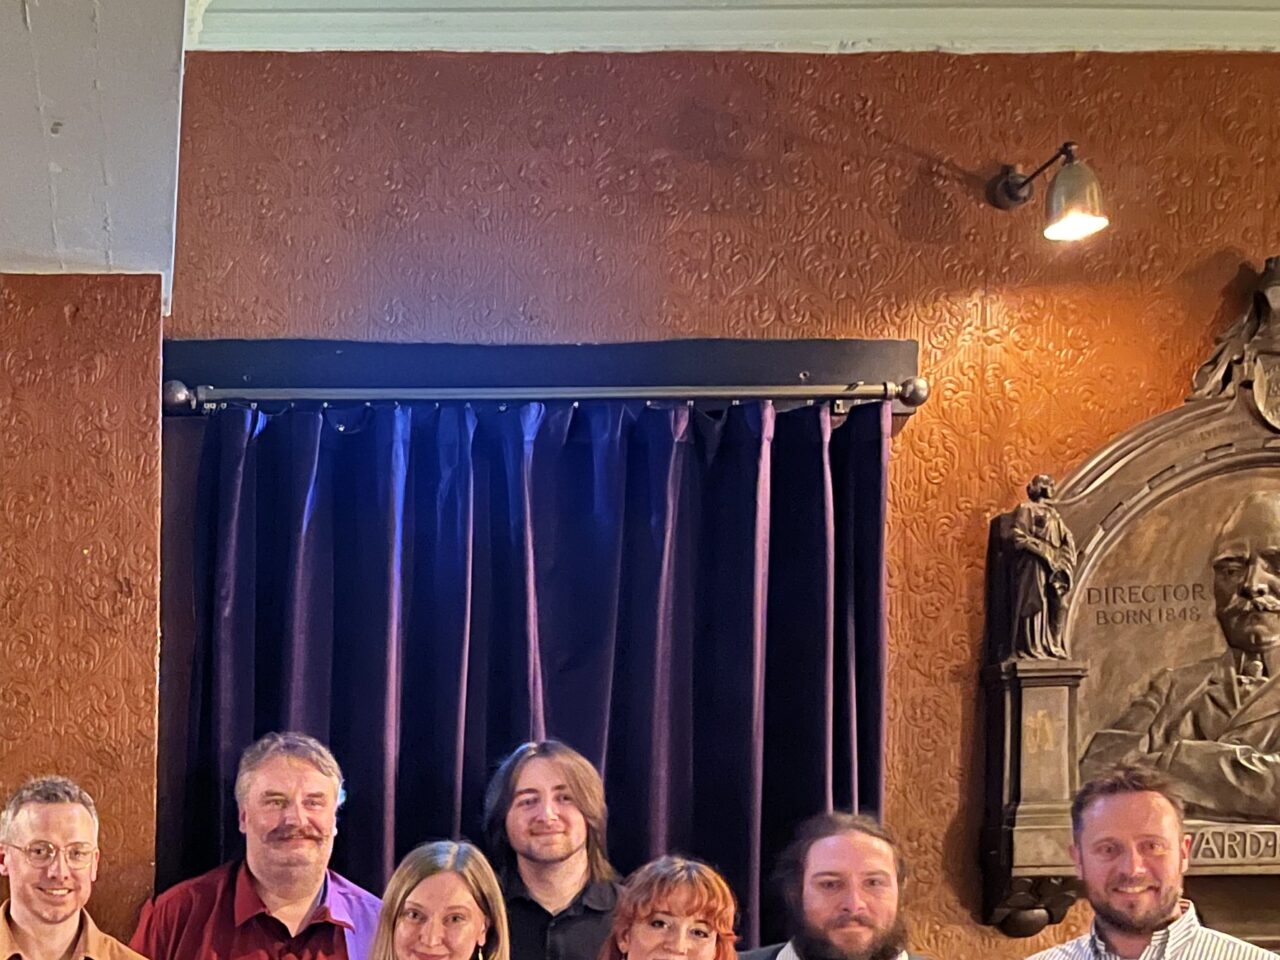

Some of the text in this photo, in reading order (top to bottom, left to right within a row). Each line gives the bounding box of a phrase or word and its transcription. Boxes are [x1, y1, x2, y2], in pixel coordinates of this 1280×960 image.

[1086, 583, 1207, 604] DIRECTOR
[1096, 605, 1200, 625] BORN 1848
